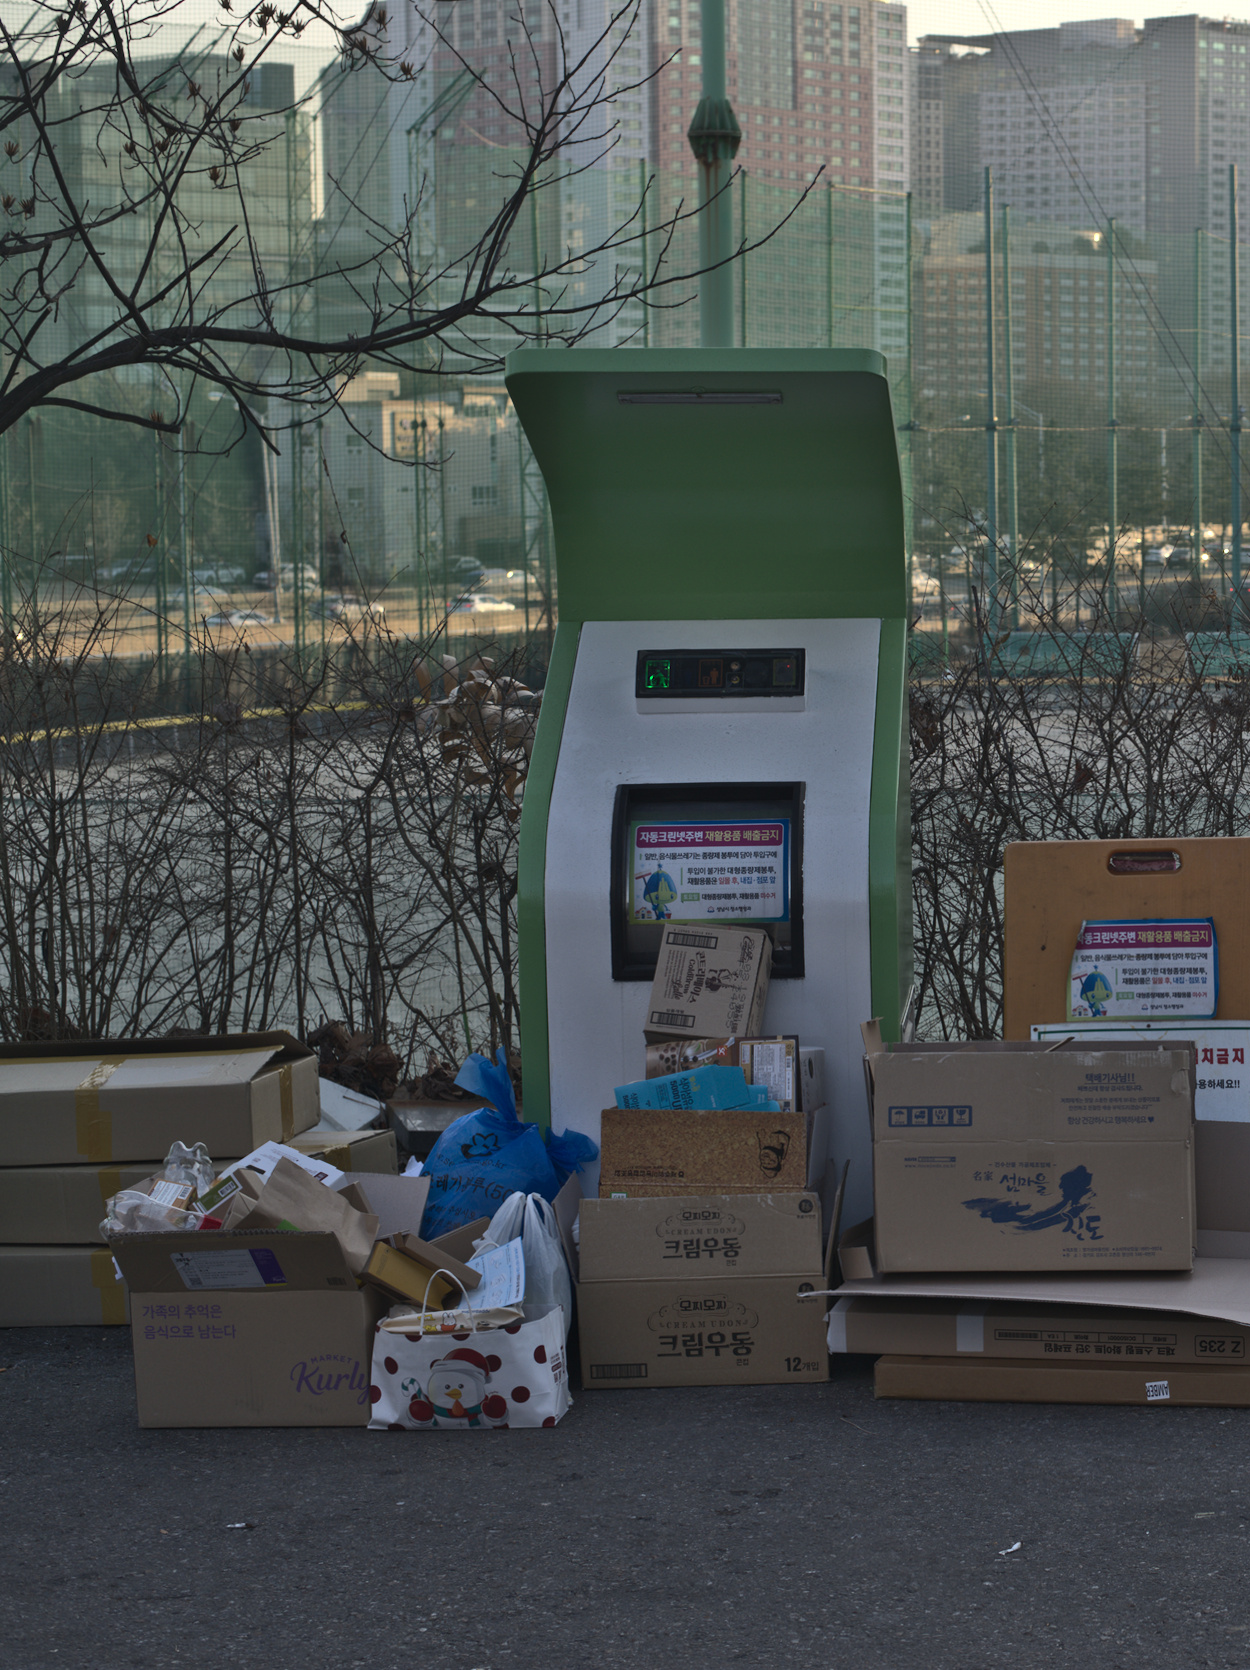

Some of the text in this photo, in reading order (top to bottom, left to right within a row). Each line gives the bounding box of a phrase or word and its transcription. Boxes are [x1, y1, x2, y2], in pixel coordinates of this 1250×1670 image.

[640, 829, 779, 843] 자동크린넷주변 재활용품 배출금지
[659, 852, 701, 860] 음식물쓰레기는
[701, 852, 720, 860] 종량제
[740, 851, 752, 859] 담아
[753, 851, 777, 859] 투입구에
[687, 867, 776, 875] 투입이 불가한 대형종량제봉투,
[687, 877, 717, 885] 재활용품은
[1137, 930, 1172, 943] 재활용품
[1173, 930, 1209, 943] 배출금지
[1135, 953, 1153, 961] 종량제
[1184, 952, 1208, 960] 투입구에
[1122, 968, 1140, 976] 투입이
[1085, 1073, 1135, 1083] 택배기사님!!
[1081, 1116, 1114, 1125] 건강하시고
[682, 1211, 721, 1221] 모찌모찌
[706, 1227, 732, 1235] UDON
[663, 1237, 742, 1259] 크림우동
[679, 1299, 727, 1312] 모찌모찌
[142, 1304, 223, 1319] 가족의 추억은
[666, 1319, 743, 1329] CREAM UDON
[143, 1324, 237, 1340] 음식으로 남는다
[656, 1331, 755, 1358] 크림우동
[1044, 1342, 1072, 1354] 프레임
[1075, 1343, 1091, 1354] 3단
[1094, 1344, 1122, 1355] 화이트
[1125, 1344, 1153, 1356] 스트링
[1199, 1339, 1241, 1353] Z 235
[310, 1354, 353, 1365] MARKET
[784, 1356, 820, 1373] 12개입
[289, 1360, 370, 1406] Kurly
[1145, 1383, 1169, 1398] AMBER
